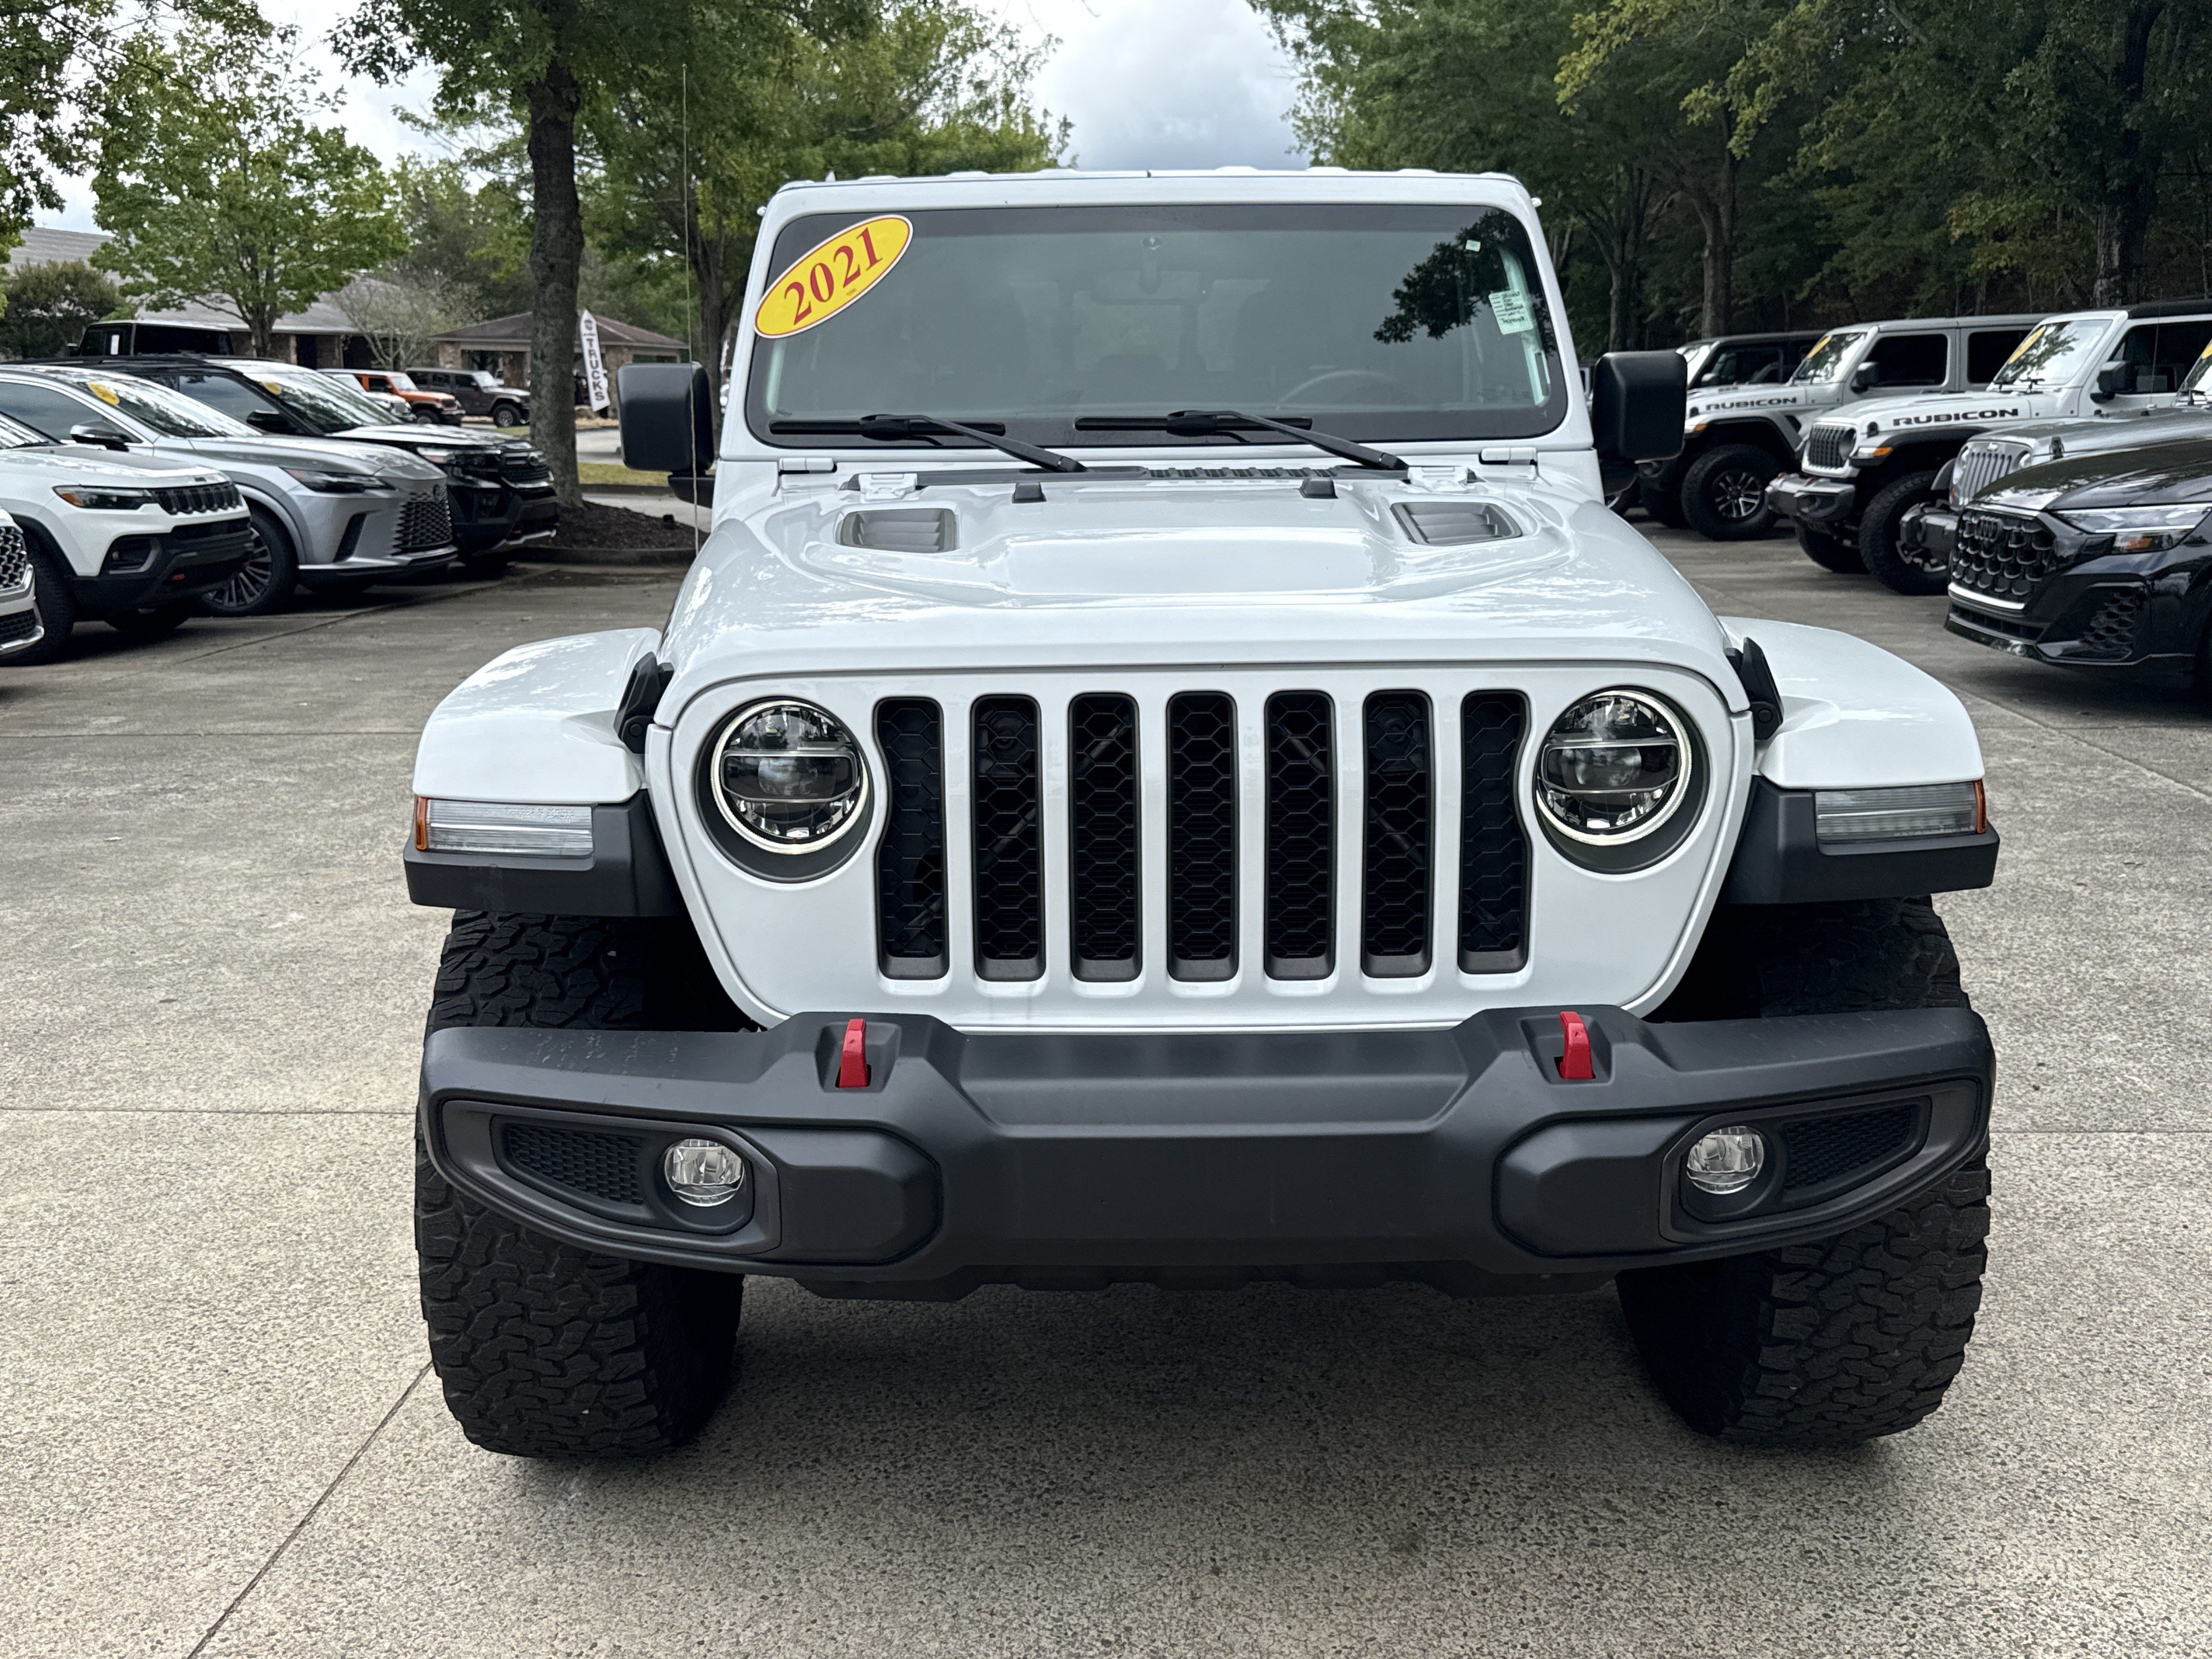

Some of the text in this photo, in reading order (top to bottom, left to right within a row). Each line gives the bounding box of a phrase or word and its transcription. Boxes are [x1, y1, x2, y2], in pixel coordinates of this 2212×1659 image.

[784, 227, 883, 325] 2021
[586, 338, 605, 401] TRUCKS
[1706, 397, 1797, 410] RUBICON
[1893, 408, 2018, 426] RUBICON
